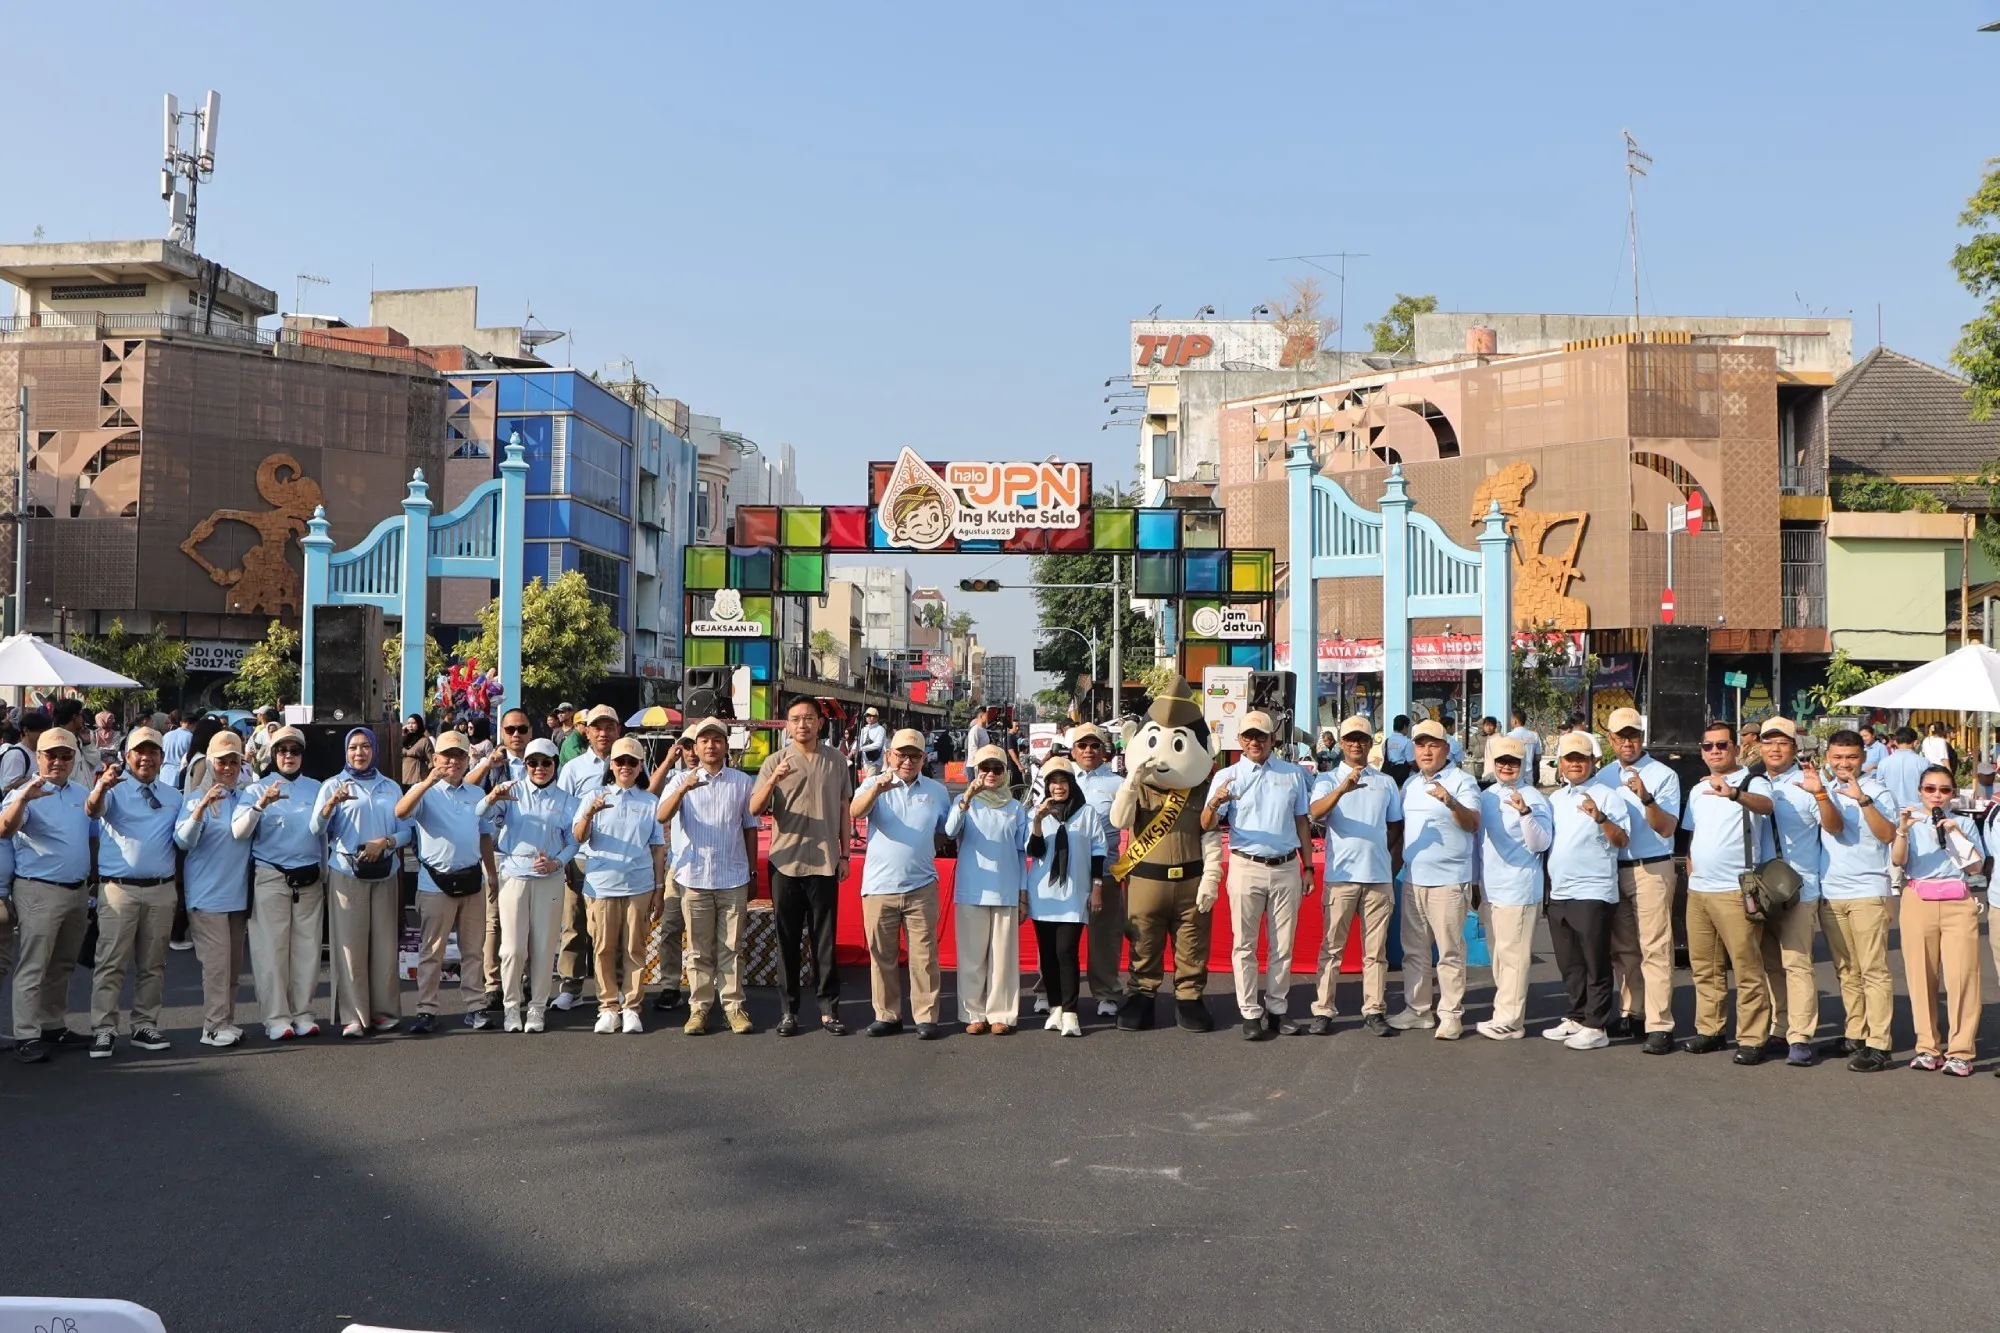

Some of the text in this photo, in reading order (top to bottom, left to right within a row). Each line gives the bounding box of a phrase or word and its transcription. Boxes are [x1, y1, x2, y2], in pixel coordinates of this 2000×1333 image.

[1137, 334, 1214, 367] TIP
[953, 469, 985, 482] halo
[968, 466, 1075, 507] JPN
[959, 509, 1076, 526] Ing Kutha Sala
[958, 528, 990, 536] Agustus
[1221, 609, 1246, 622] jam
[695, 624, 747, 632] KEJAKSAAN
[1223, 621, 1262, 632] datun
[213, 648, 243, 659] ONG
[1326, 645, 1351, 657] KITA
[1127, 792, 1185, 864] KEJAKSAAN RI
